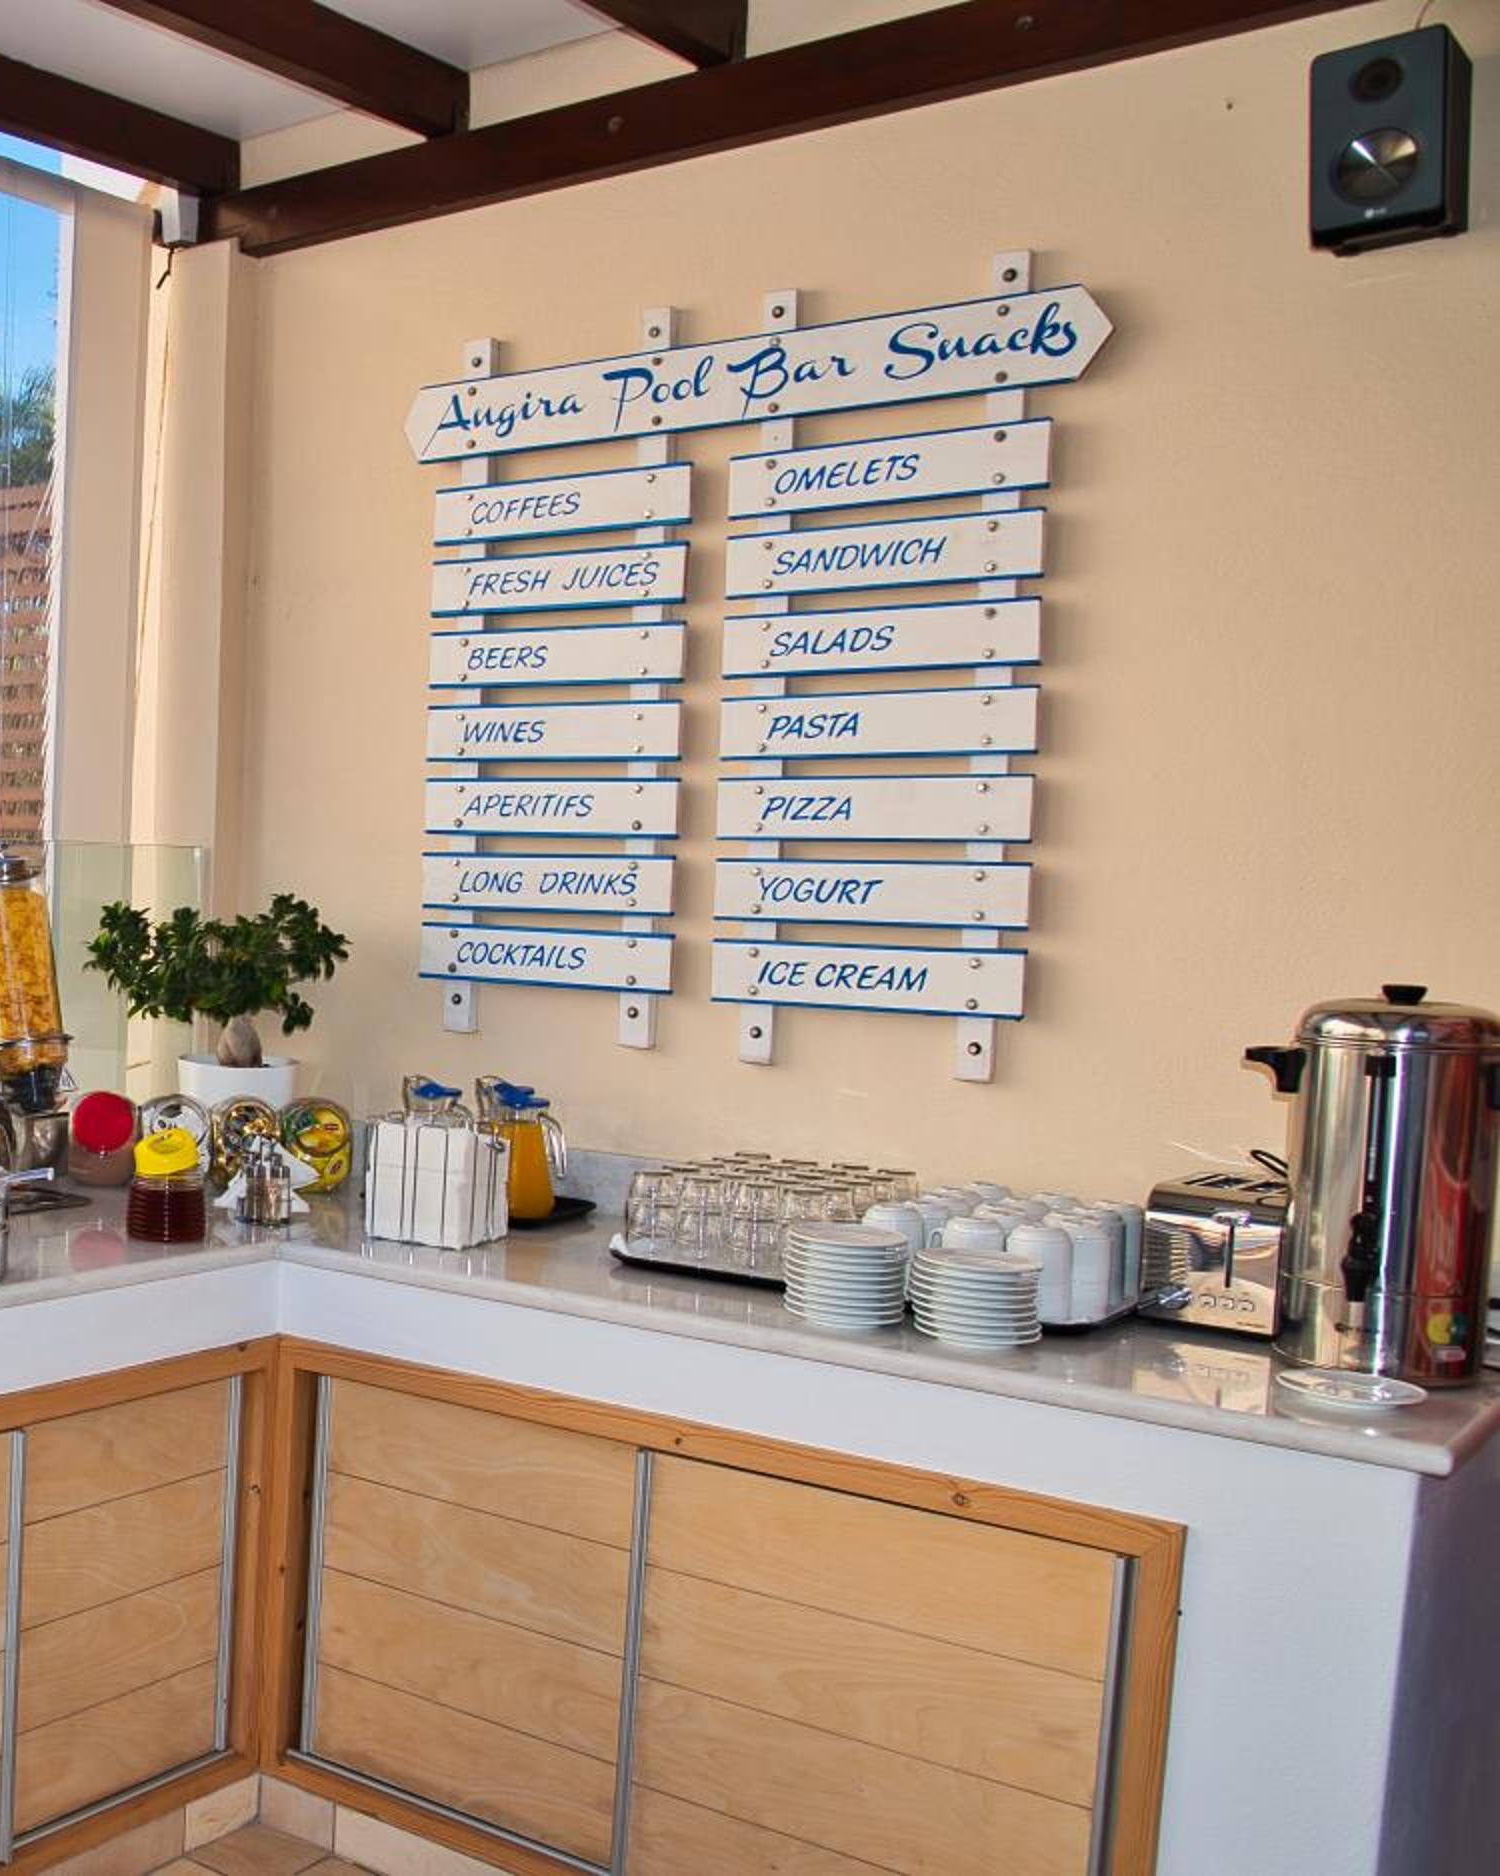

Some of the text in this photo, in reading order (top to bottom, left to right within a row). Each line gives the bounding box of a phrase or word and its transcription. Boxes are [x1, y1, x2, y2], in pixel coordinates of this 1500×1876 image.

[420, 301, 1078, 457] Angira Pool Bar Snacks
[775, 454, 921, 495] OMELETS
[471, 492, 580, 527] COFFEES
[774, 536, 947, 576] SANDWICH
[468, 561, 658, 597] FRESH JUICES
[772, 624, 894, 657] SALADS
[467, 645, 548, 670] BEERS
[463, 719, 544, 744] WINES
[767, 711, 863, 740] PASTA
[464, 793, 592, 818] APERITIFS
[761, 795, 853, 823] PIZZA
[459, 870, 638, 896] LONG DRINKS
[761, 876, 883, 906] YOGURT
[457, 940, 587, 970] COCKTAILS
[758, 959, 929, 993] ICE CREAM
